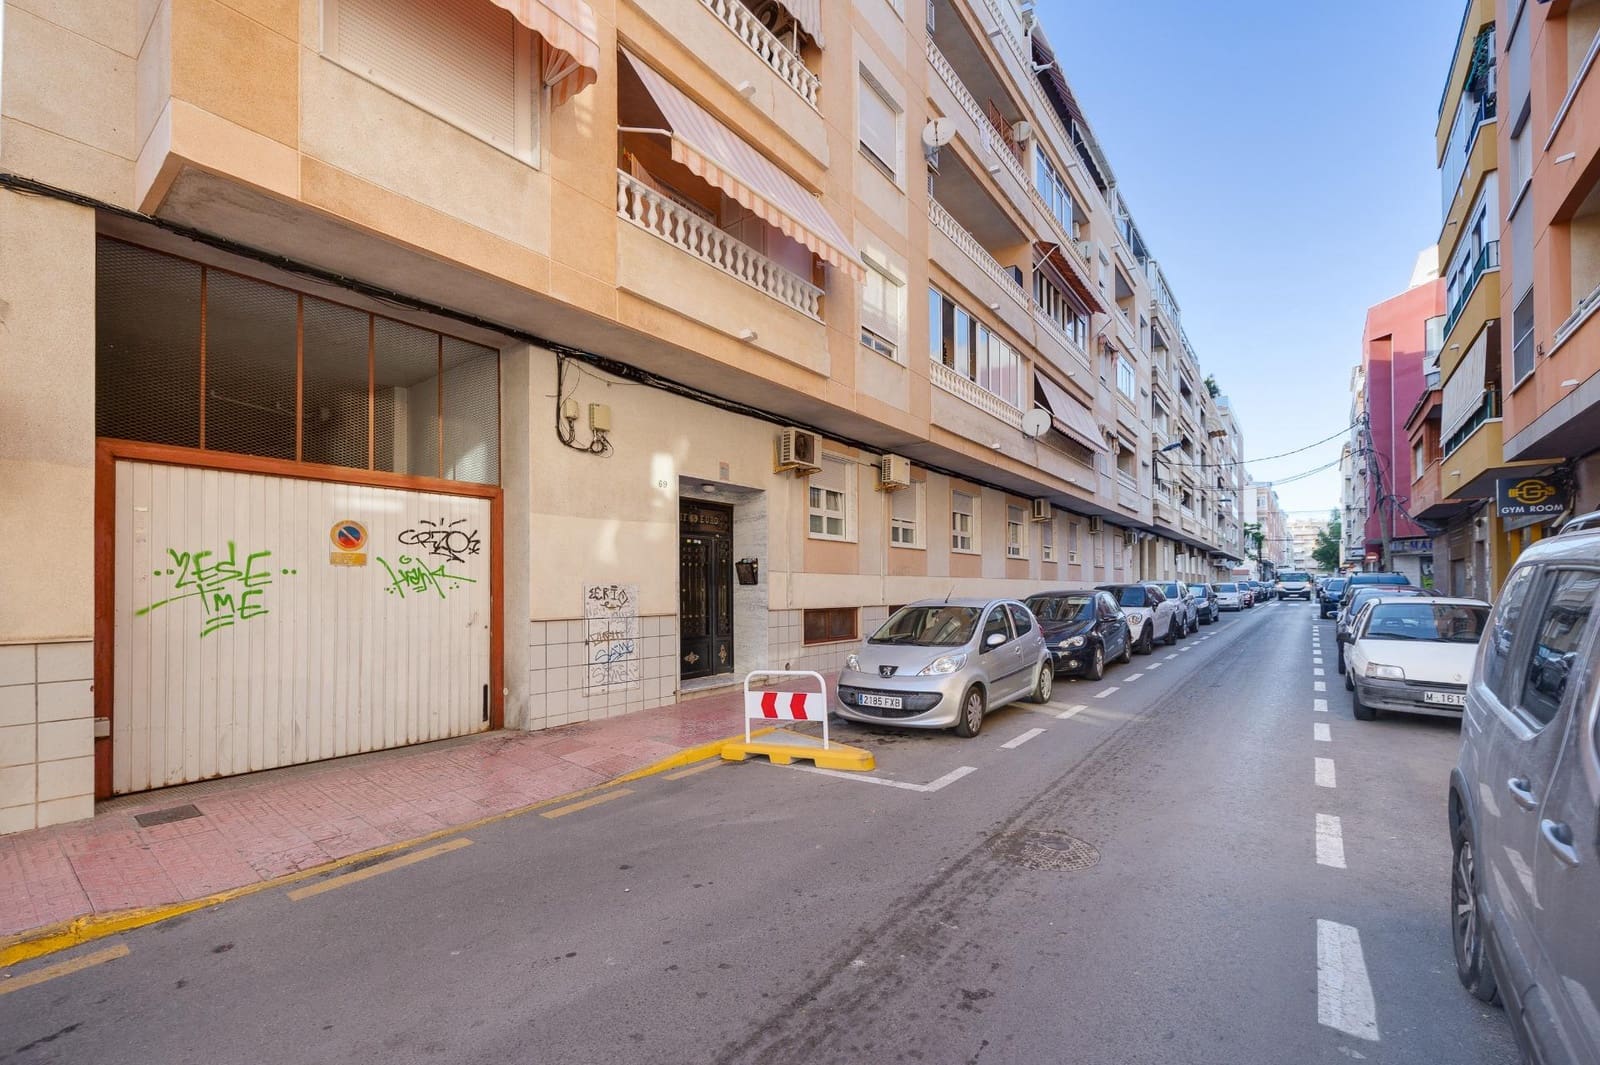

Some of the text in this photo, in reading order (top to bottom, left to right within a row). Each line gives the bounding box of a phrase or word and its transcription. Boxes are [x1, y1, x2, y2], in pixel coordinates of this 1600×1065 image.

[658, 480, 668, 488] 69
[1501, 504, 1564, 514] GYM ROOM
[863, 695, 883, 706] 2185
